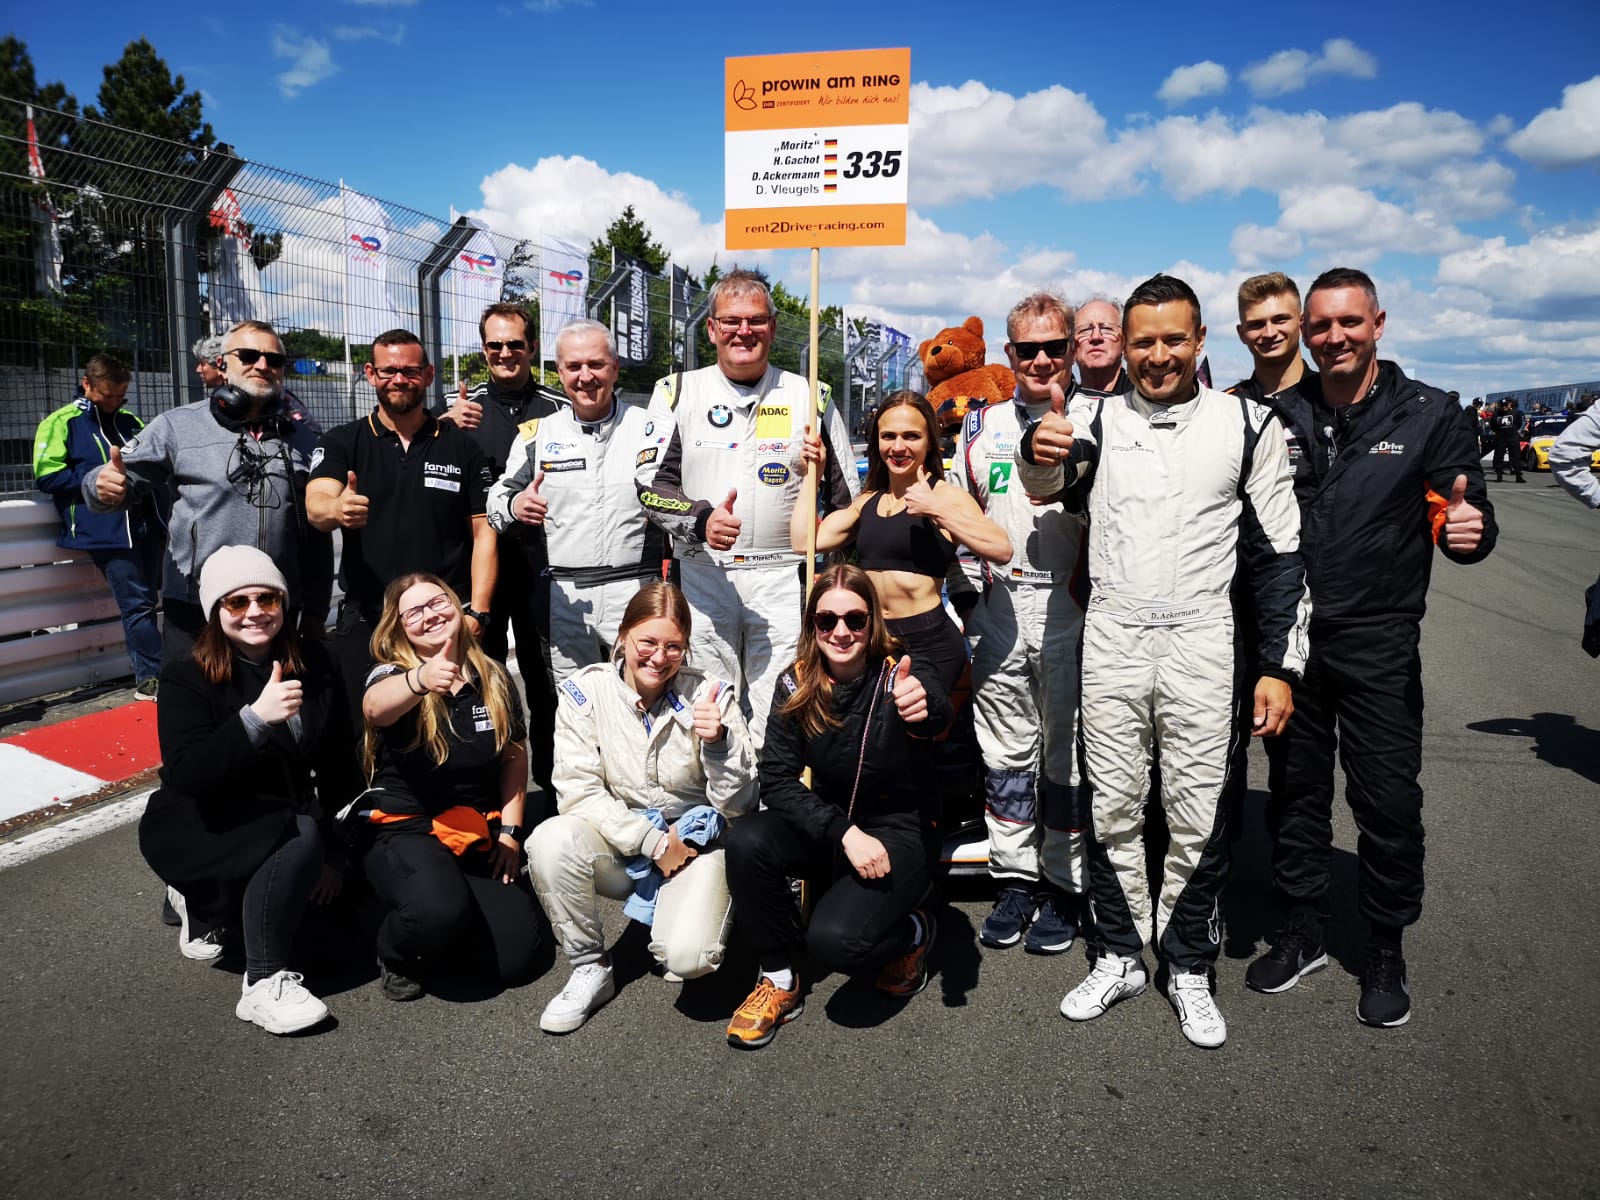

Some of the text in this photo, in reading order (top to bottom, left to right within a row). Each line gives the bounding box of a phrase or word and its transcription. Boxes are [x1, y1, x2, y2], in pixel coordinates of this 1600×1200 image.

[827, 75, 855, 89] am
[862, 74, 900, 88] RING
[818, 95, 832, 105] Wir
[836, 94, 859, 105] bilden
[862, 93, 880, 104] dich
[843, 150, 902, 179] 335
[763, 171, 820, 181] Ackermann
[756, 184, 819, 197] D. Vleugels
[745, 221, 885, 234] rent2Drive-racing.com
[630, 264, 643, 361] GRAN TURISMO
[760, 407, 789, 416] ADAC
